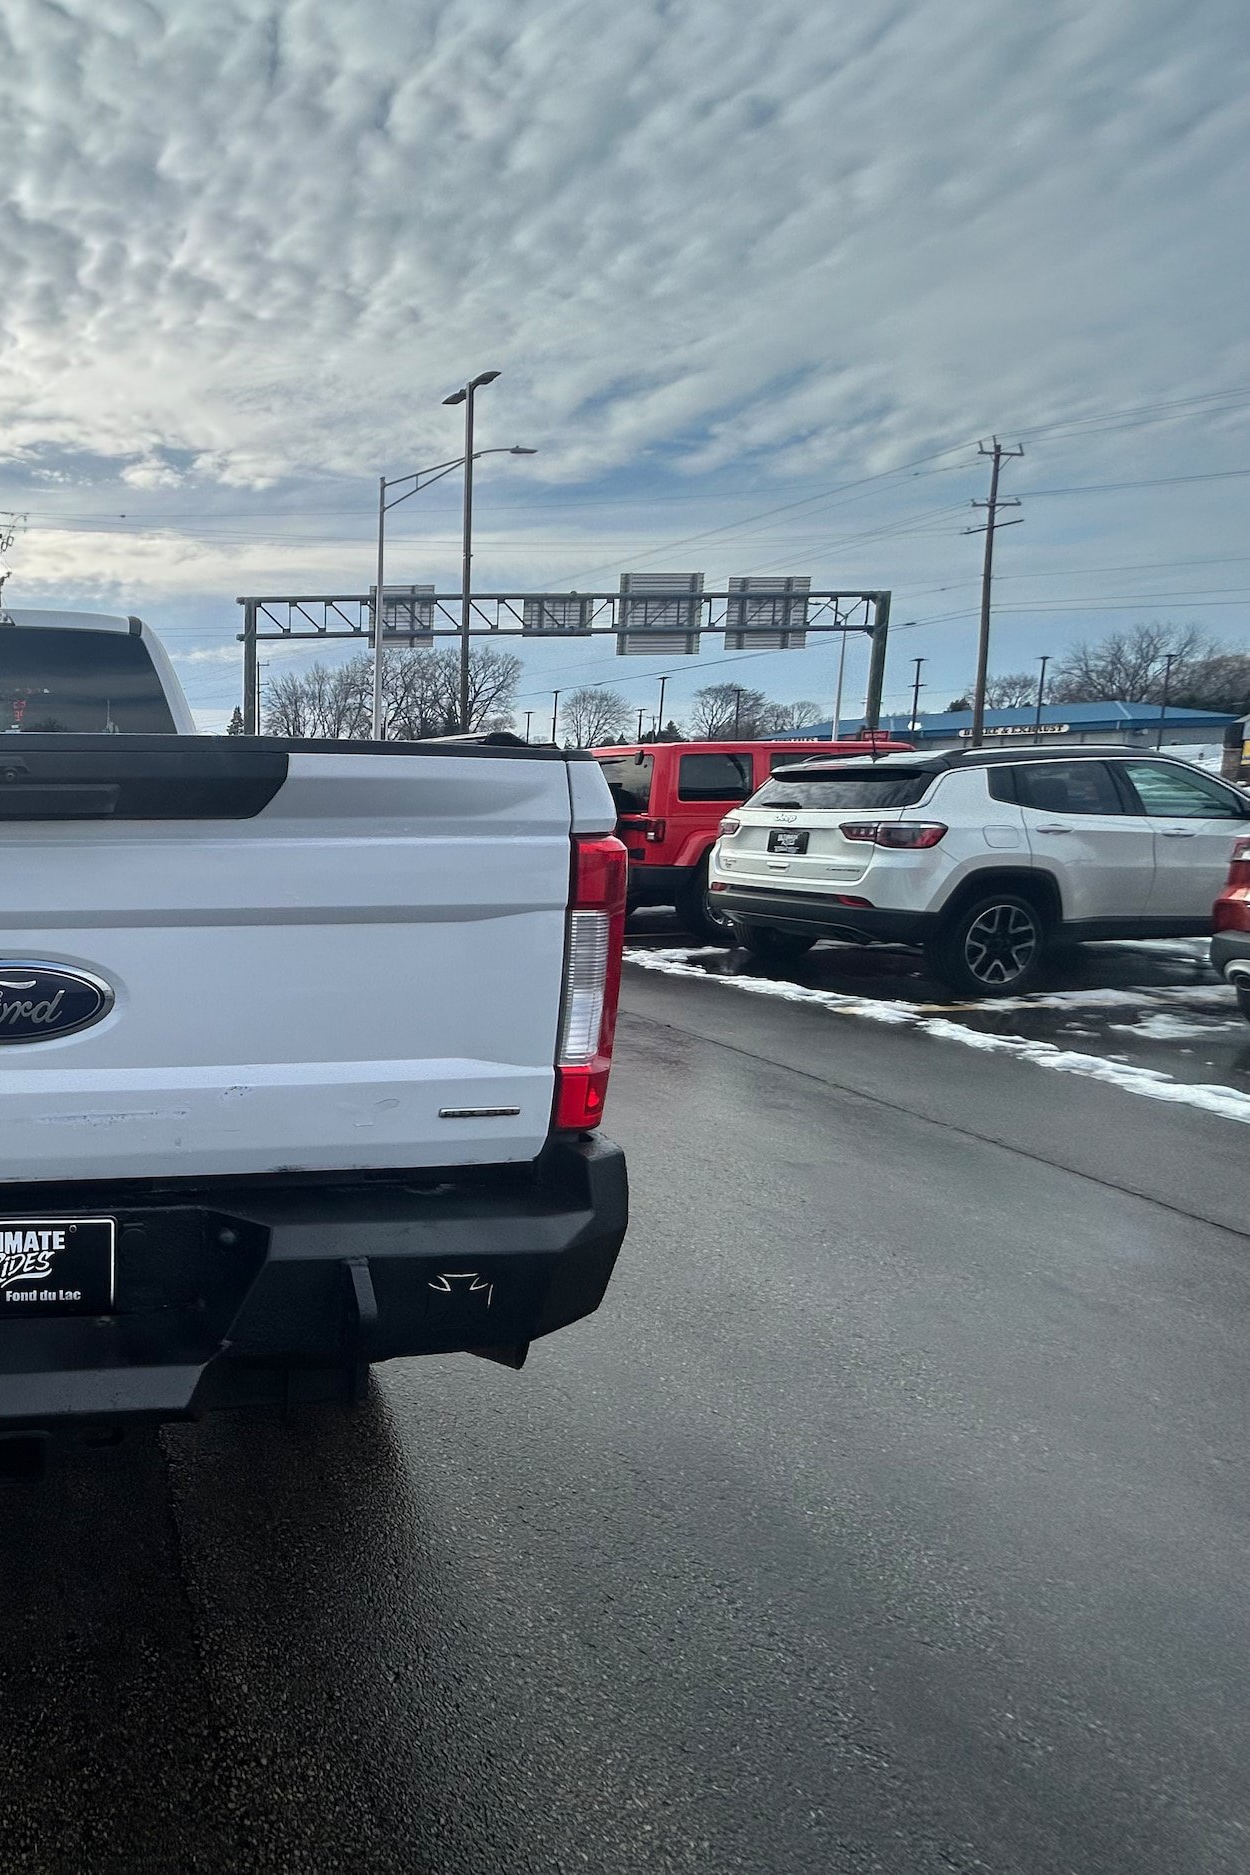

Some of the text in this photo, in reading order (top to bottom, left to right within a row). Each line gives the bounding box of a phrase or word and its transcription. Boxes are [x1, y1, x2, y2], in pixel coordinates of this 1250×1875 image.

[5, 1289, 37, 1302] Fond
[39, 1289, 57, 1302] du
[59, 1289, 81, 1301] Lac
